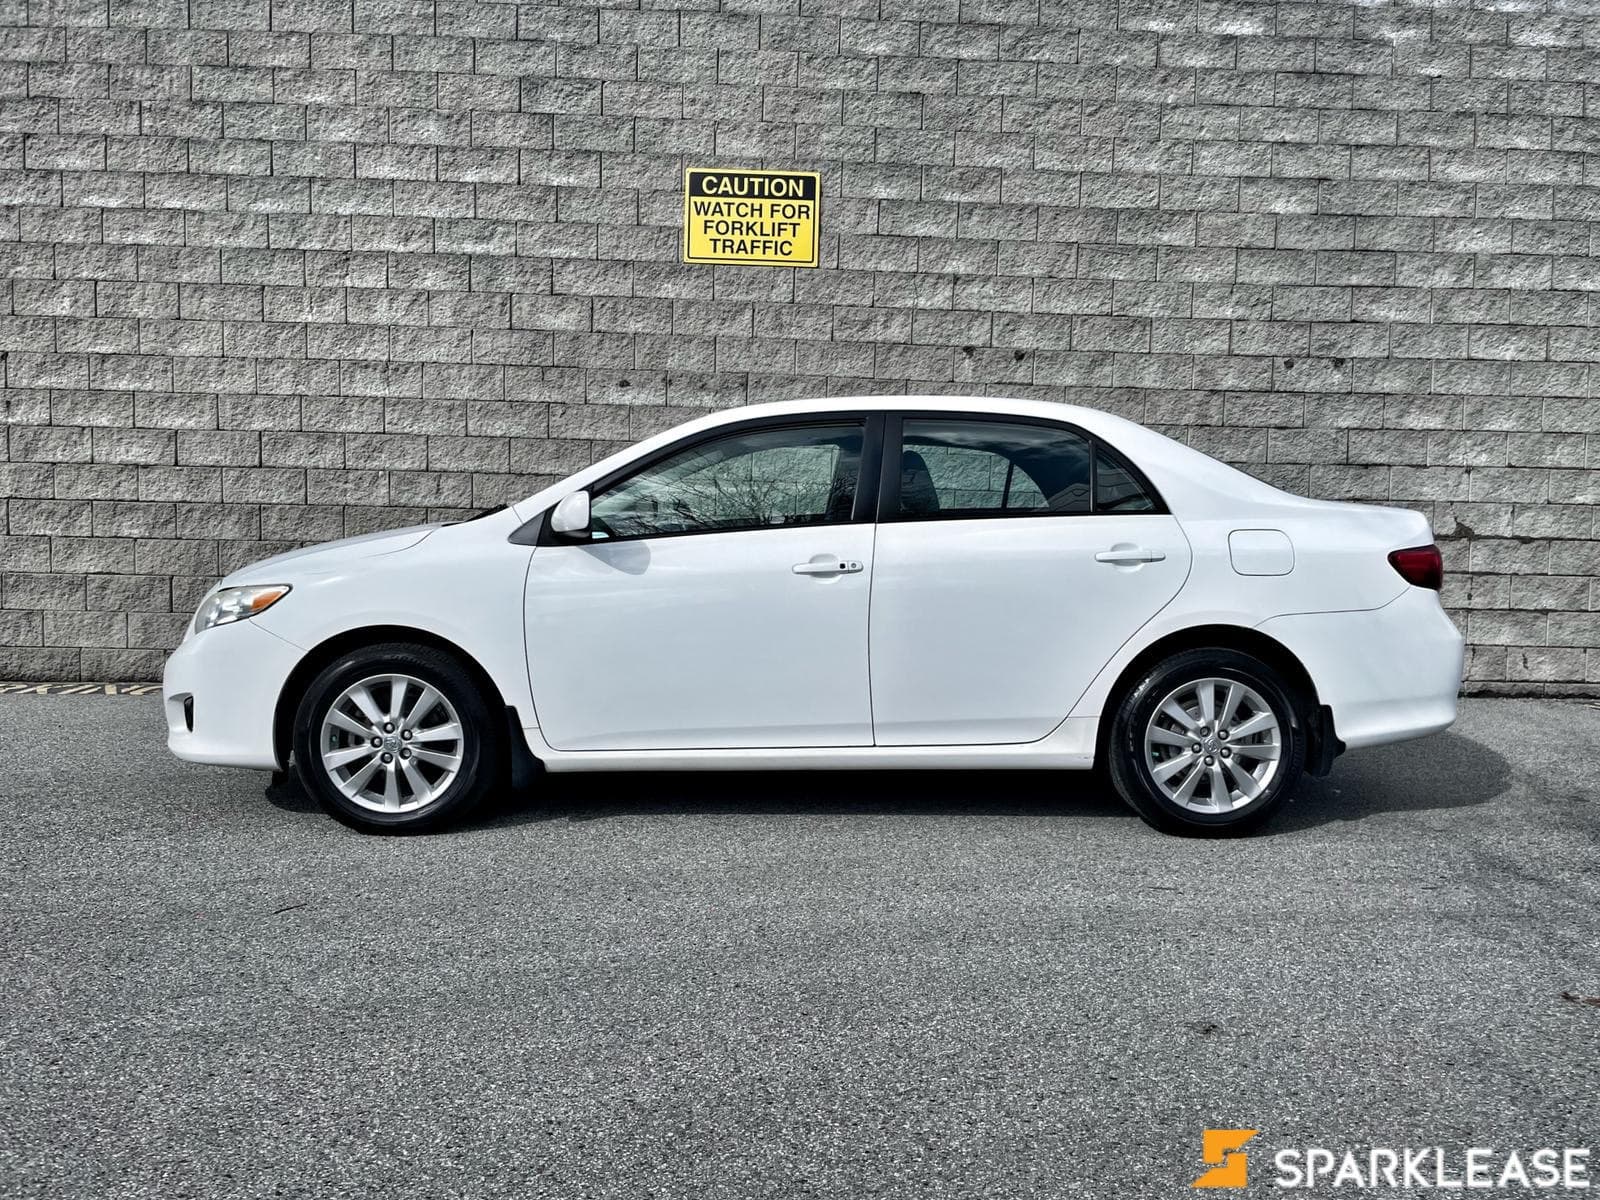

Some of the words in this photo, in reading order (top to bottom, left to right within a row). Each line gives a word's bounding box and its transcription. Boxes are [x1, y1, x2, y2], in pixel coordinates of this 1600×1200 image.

[701, 175, 804, 197] CAUTION
[693, 200, 763, 218] WATCH
[770, 203, 811, 220] FOR
[703, 219, 801, 238] FORKLIFT
[709, 238, 793, 256] TRAFFIC
